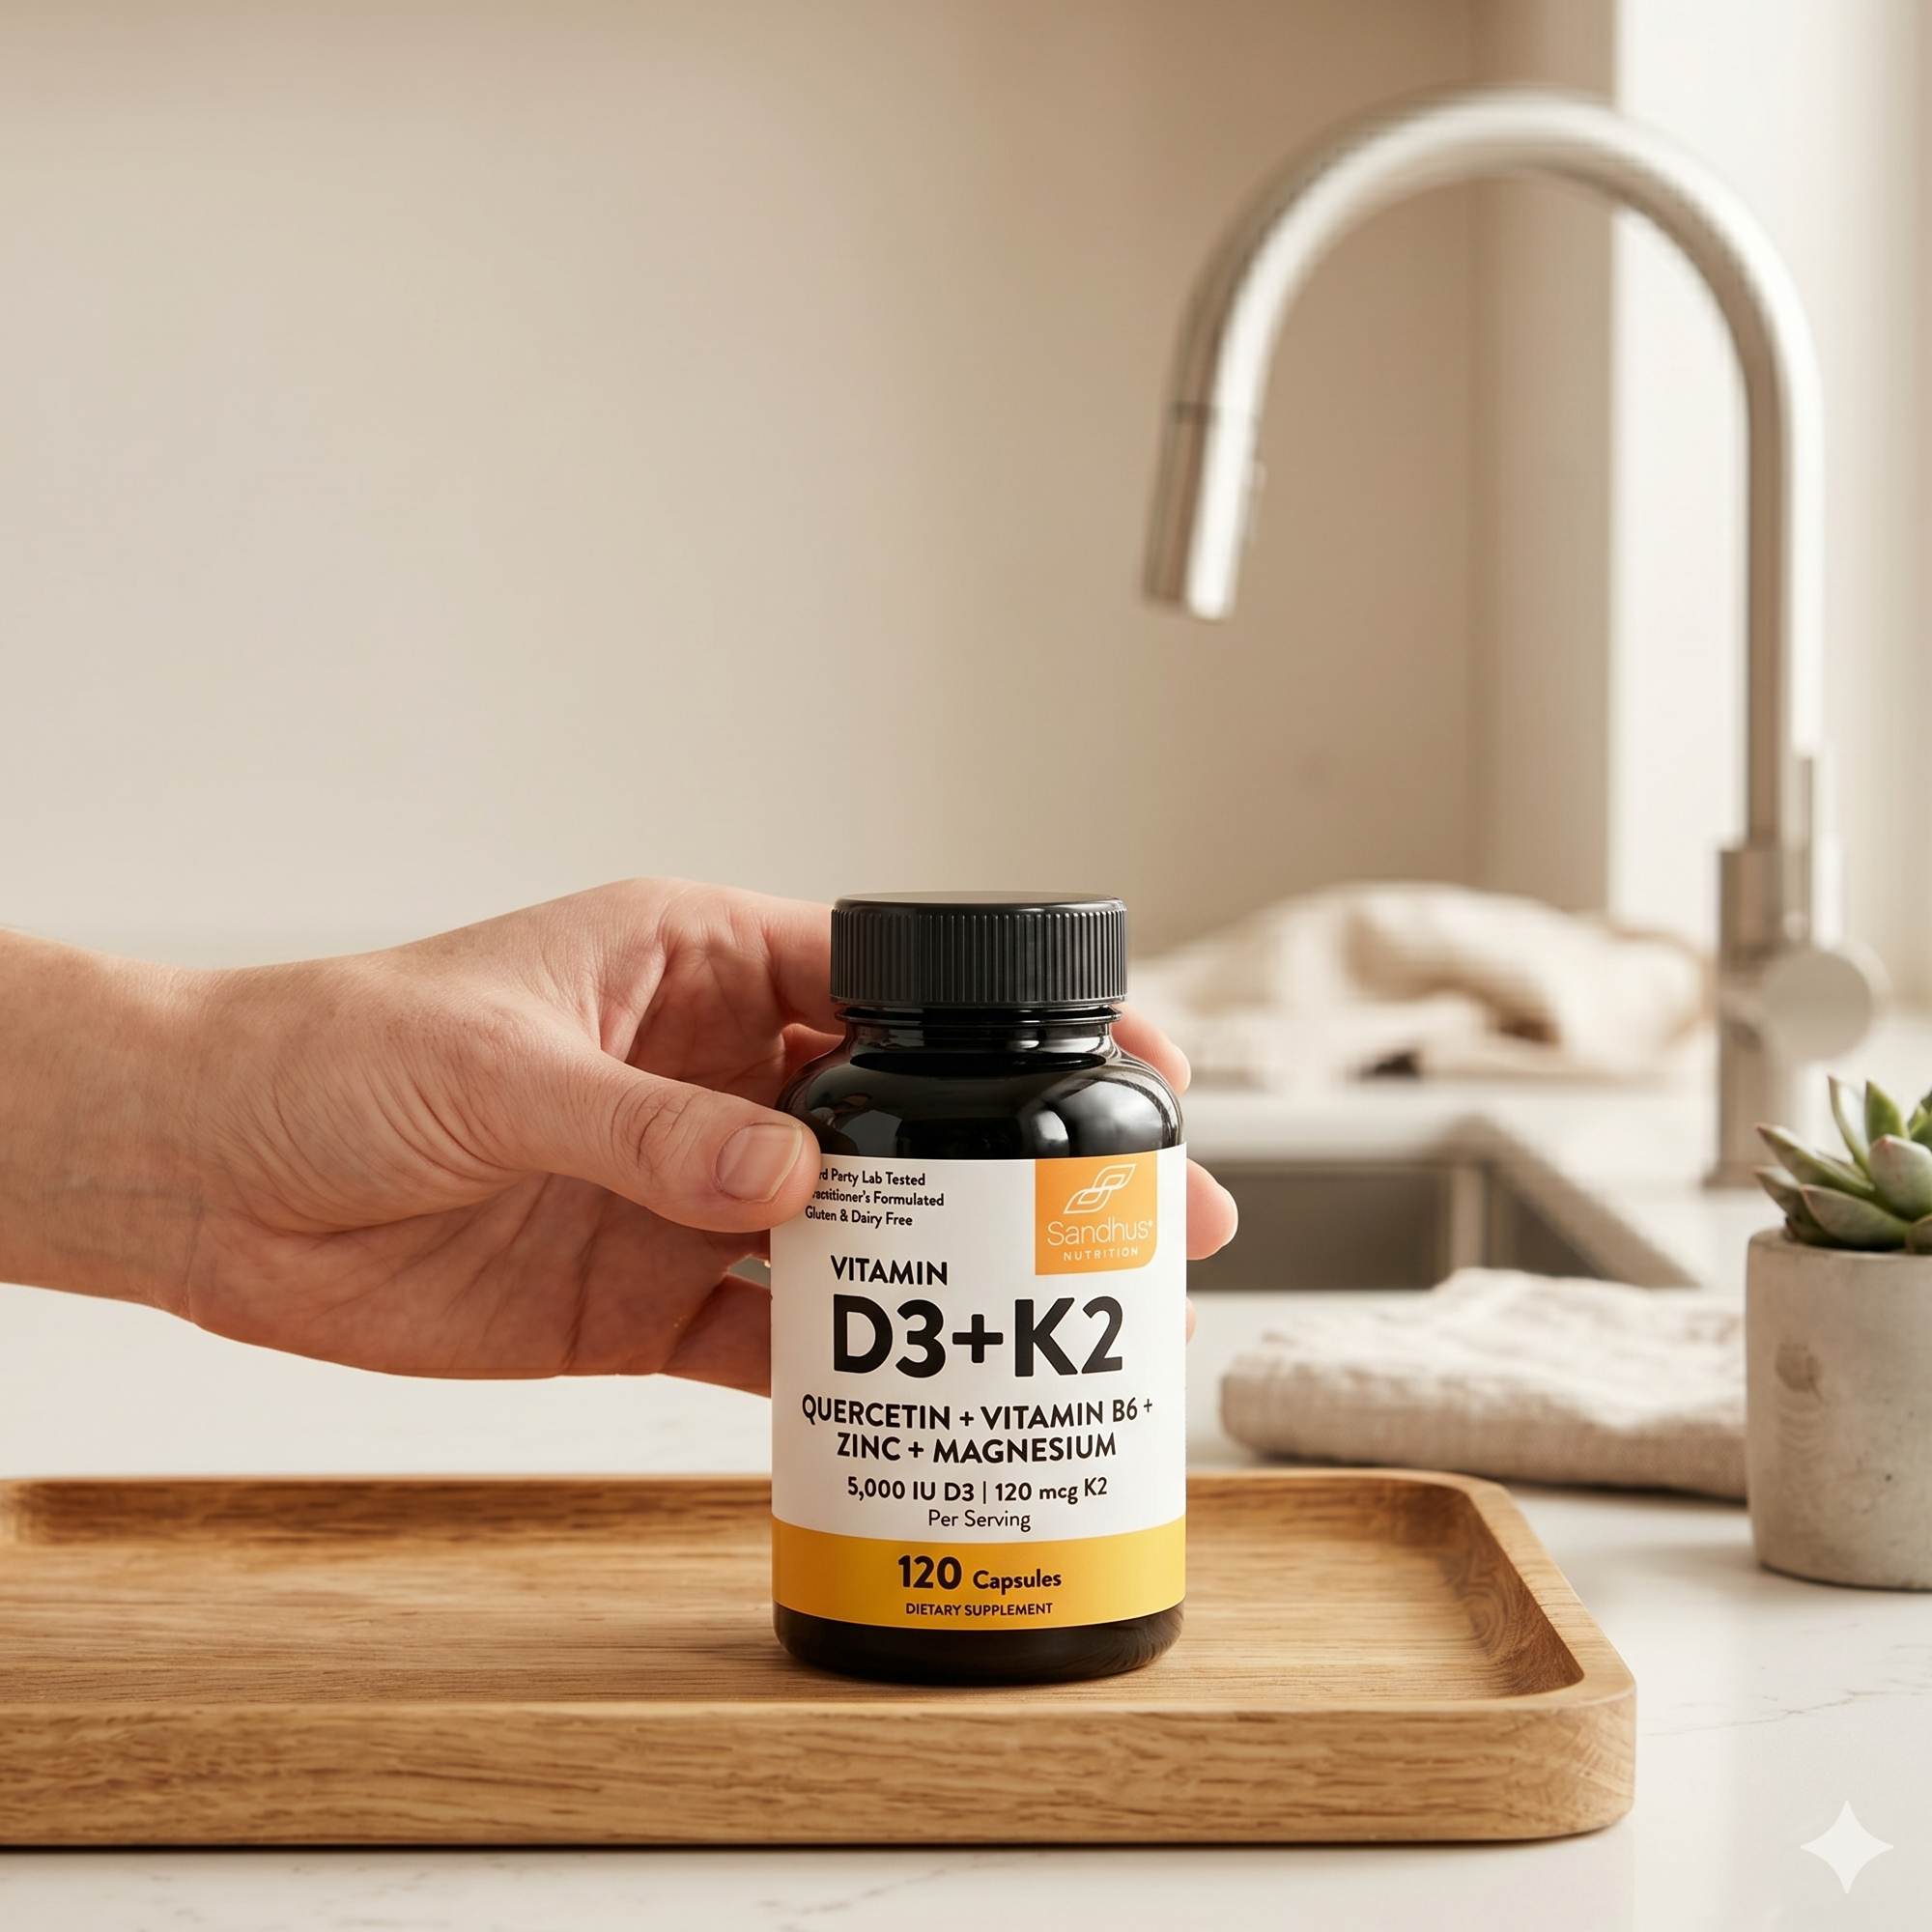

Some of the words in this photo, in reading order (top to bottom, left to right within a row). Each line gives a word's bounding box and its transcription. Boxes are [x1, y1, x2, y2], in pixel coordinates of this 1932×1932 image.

[831, 1167, 860, 1187] Party
[862, 1170, 883, 1184] Lab
[885, 1171, 925, 1186] Tested
[811, 1187, 871, 1204] ractitioner's
[873, 1190, 945, 1207] Formulated
[805, 1205, 838, 1222] Gluten
[839, 1208, 849, 1223] &
[851, 1208, 883, 1230] Dairy
[885, 1211, 913, 1227] Free
[1063, 1246, 1139, 1262] NUTRITION
[830, 1254, 949, 1286] VITAMIN
[833, 1293, 1124, 1378] D3+K2
[802, 1393, 951, 1431] QUERCETIN
[959, 1410, 975, 1427] +
[980, 1401, 1103, 1431] VITAMIN
[1112, 1397, 1138, 1423] B6
[1143, 1398, 1153, 1413] +
[837, 1431, 901, 1462] ZINC
[907, 1440, 924, 1459] +
[932, 1432, 1117, 1464] MAGNESIUM
[847, 1475, 906, 1502] 5,000
[913, 1480, 936, 1501] IU
[944, 1482, 975, 1502] D3
[995, 1482, 1033, 1502] 120
[1039, 1486, 1079, 1505] mcg
[1084, 1476, 1108, 1497] K2
[928, 1509, 959, 1527] Per
[964, 1509, 1032, 1533] Serving
[897, 1554, 963, 1591] 120
[972, 1568, 1063, 1596] Capsules
[905, 1602, 963, 1617] DIETARY
[964, 1602, 1054, 1617] SUPPLEMENT
